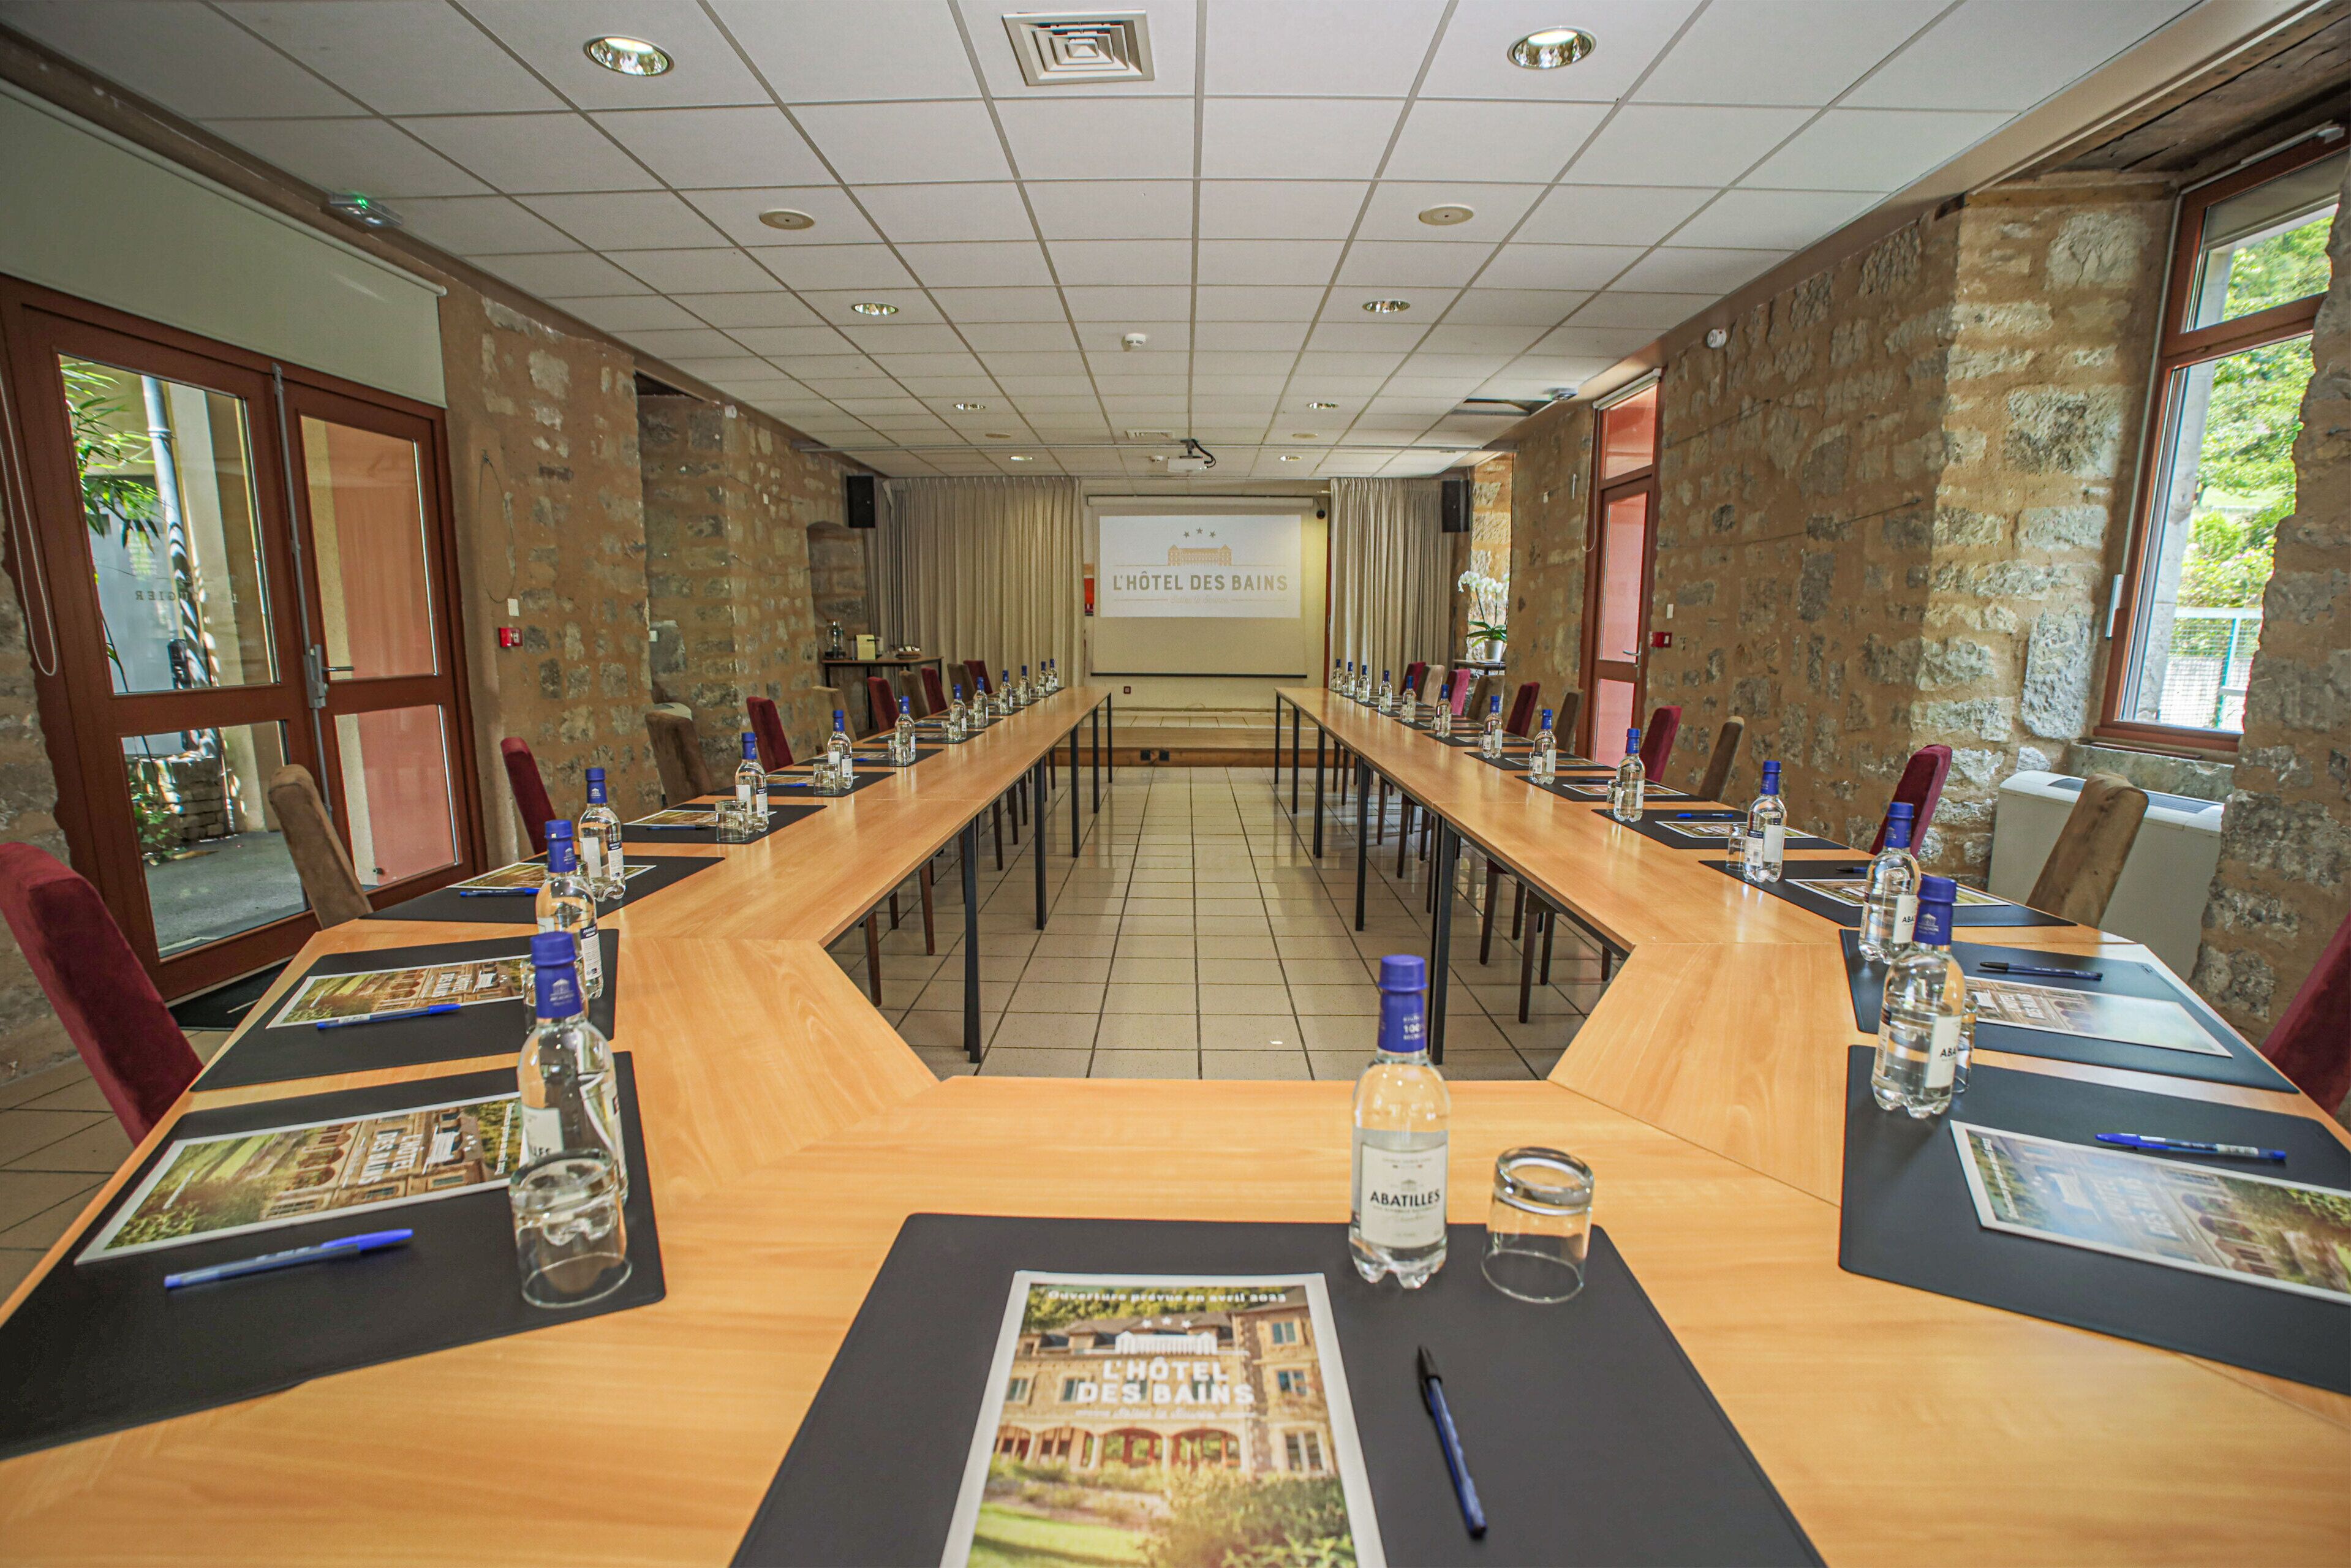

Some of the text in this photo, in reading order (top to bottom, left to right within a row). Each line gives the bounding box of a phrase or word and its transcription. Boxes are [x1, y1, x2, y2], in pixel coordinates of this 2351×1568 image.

[1113, 571, 1288, 592] L'HÔTEL DES BAINS
[1370, 1188, 1441, 1207] ABATILLES
[1047, 1289, 1128, 1302] Ouverture
[1187, 1294, 1205, 1303] en
[1209, 1292, 1246, 1303] avril
[1103, 1355, 1229, 1382] L'HÔTEL
[1076, 1381, 1255, 1405] DES BAINS
